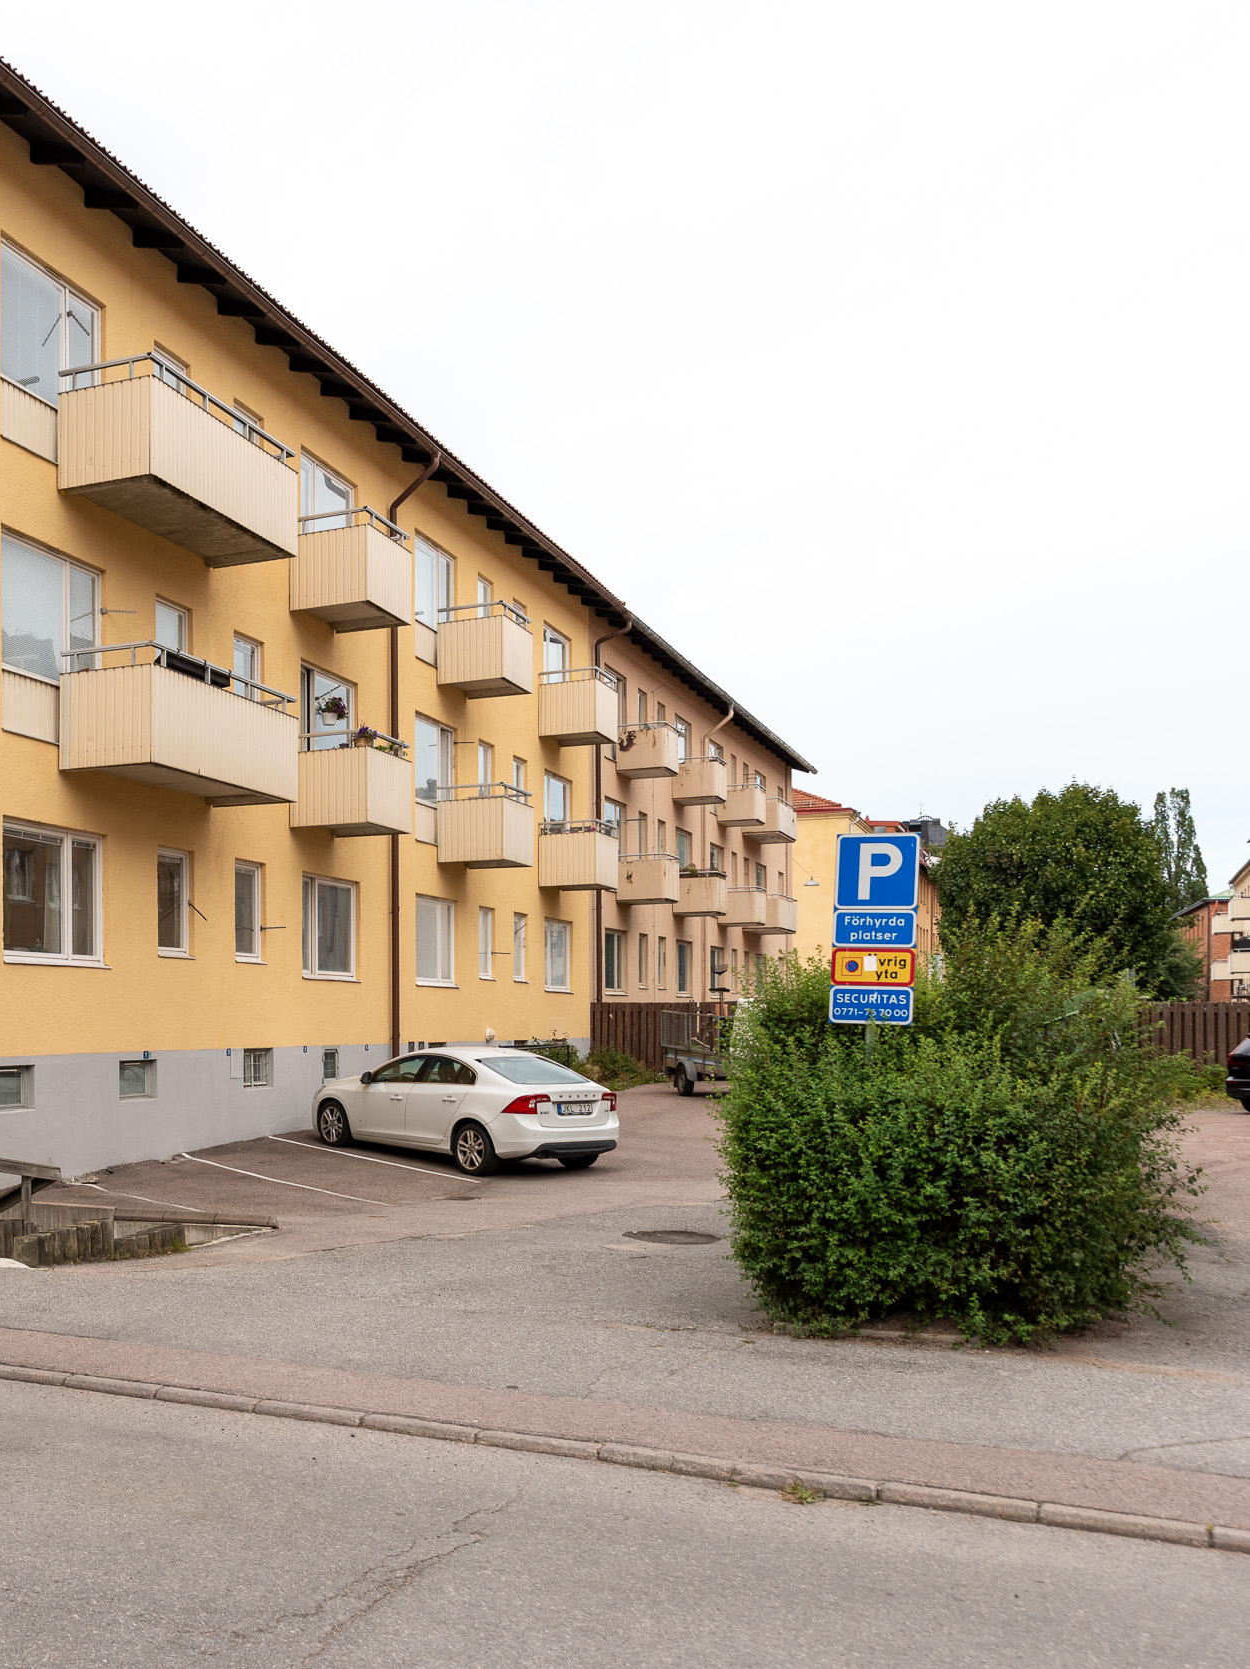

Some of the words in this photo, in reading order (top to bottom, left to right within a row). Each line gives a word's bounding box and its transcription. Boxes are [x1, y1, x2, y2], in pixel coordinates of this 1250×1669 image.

[857, 843, 903, 900] P
[844, 915, 905, 929] Förhyrda
[850, 929, 898, 942] platser
[875, 968, 898, 982] yta
[836, 993, 907, 1005] SECURITAS
[562, 1104, 575, 1113] JKL
[578, 1104, 591, 1112] 212
